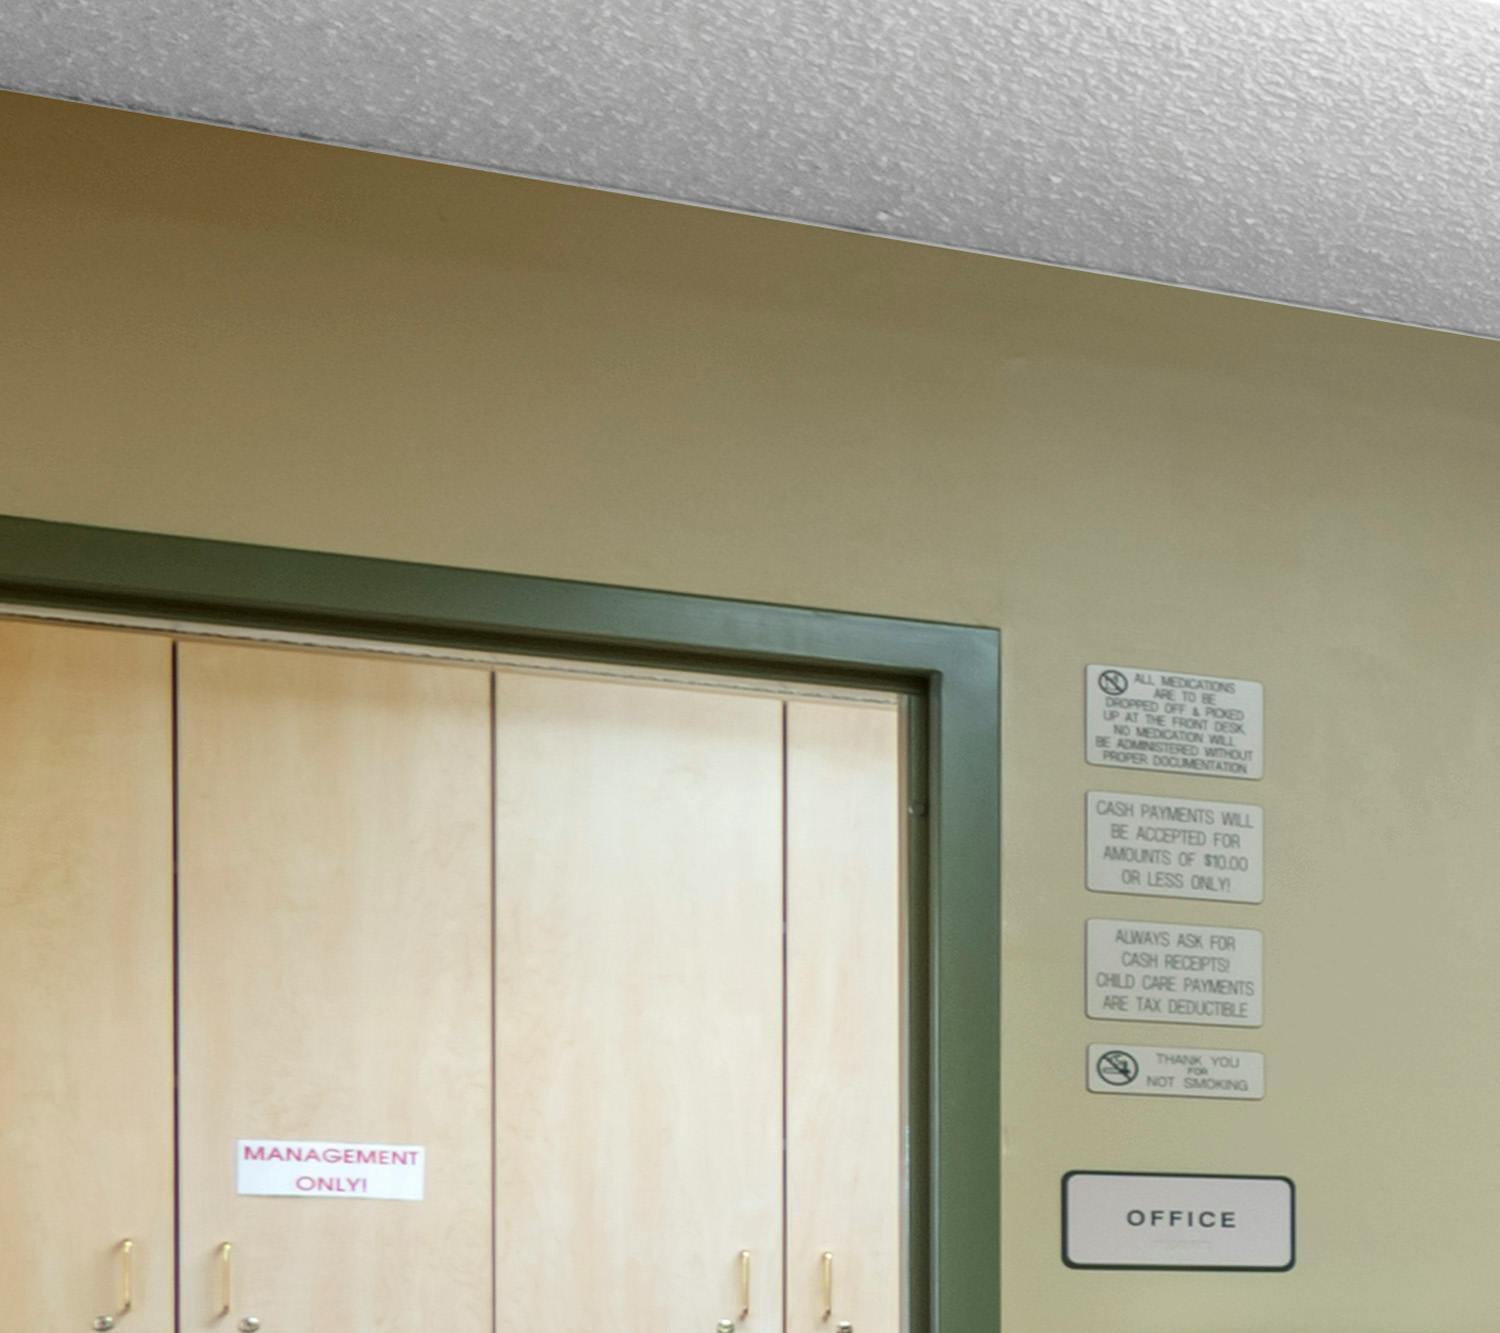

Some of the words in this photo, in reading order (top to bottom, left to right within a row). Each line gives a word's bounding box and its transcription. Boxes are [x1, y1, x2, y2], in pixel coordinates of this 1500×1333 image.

[1135, 673, 1154, 686] ALL
[1161, 676, 1236, 694] MEDICATIONS
[1154, 688, 1176, 700] ARE
[1182, 690, 1196, 702] TO
[1202, 693, 1216, 706] BE
[1106, 696, 1158, 712] DROPPED
[1164, 703, 1186, 714] OFF
[1192, 706, 1200, 716] &
[1205, 707, 1244, 721] PICKED
[1104, 710, 1119, 720] UP
[1124, 712, 1138, 722] AT
[1146, 714, 1166, 726] THE
[1172, 716, 1208, 730] FRONT
[1114, 725, 1130, 736] NO
[1136, 728, 1204, 743] MEDICATION
[1208, 734, 1234, 747] WILL
[1096, 736, 1110, 748] BE
[1117, 739, 1198, 756] ADMINISTERED
[1205, 747, 1253, 761] WITHOUT
[1104, 751, 1148, 764] PROPER
[1154, 756, 1248, 774] DOCUMENTATION
[1096, 800, 1134, 816] CASH
[1140, 804, 1214, 824] PAYMENTS
[1221, 812, 1254, 828] WILL
[1111, 824, 1128, 840] BE
[1136, 826, 1206, 846] ACCEPTED
[1214, 832, 1240, 848] FOR
[1104, 846, 1172, 866] AMOUNTS
[1178, 852, 1196, 866] OF
[1204, 854, 1248, 872] $10.00
[1122, 869, 1140, 885] OR
[1148, 872, 1184, 888] LESS
[1191, 874, 1230, 892] ONLY!
[1116, 929, 1170, 948] ALWAYS
[1176, 934, 1204, 948] ASK
[1210, 935, 1236, 950] FOR
[1122, 952, 1158, 968] CASH
[1164, 954, 1230, 973] RECEIPTS!
[1096, 972, 1135, 989] CHILD
[1142, 975, 1176, 992] CARE
[1184, 978, 1254, 996] PAYMENTS
[1103, 995, 1128, 1011] ARE
[1136, 997, 1161, 1013] TAX
[1168, 999, 1248, 1018] DEDUCTIBLE
[1156, 1053, 1202, 1066] THANK
[1211, 1056, 1240, 1068] YOU
[1187, 1068, 1208, 1076] FOR
[1147, 1076, 1174, 1088] NOT
[1184, 1078, 1248, 1092] SMOKING
[243, 1146, 418, 1166] MANAGEMENT
[296, 1176, 367, 1192] ONLY!
[1126, 1210, 1236, 1228] OFFICE
